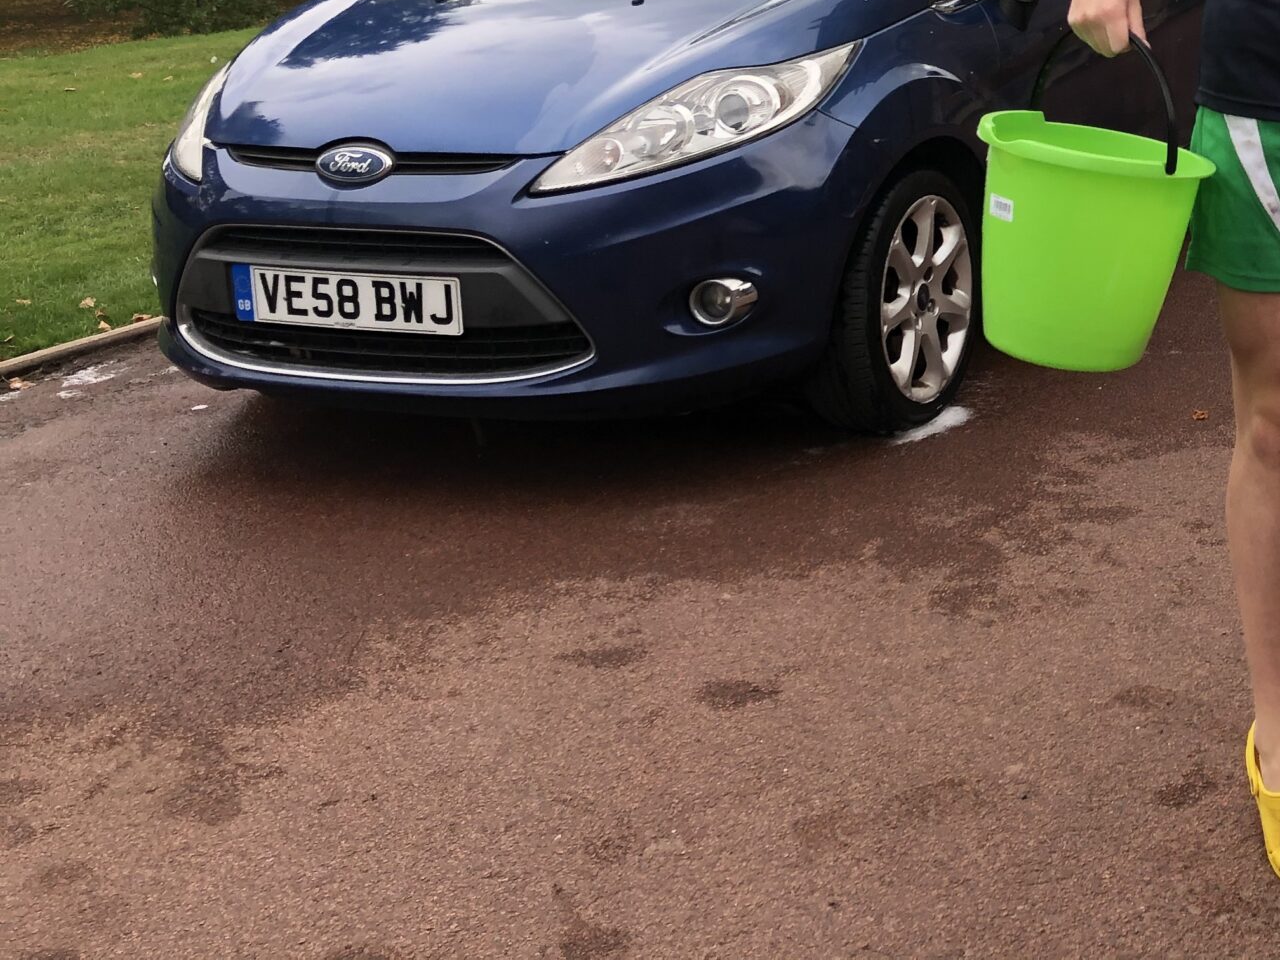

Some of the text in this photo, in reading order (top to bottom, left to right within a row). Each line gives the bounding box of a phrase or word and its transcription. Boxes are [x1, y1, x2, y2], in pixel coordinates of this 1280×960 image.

[329, 152, 372, 173] Ford
[237, 299, 251, 311] GB
[259, 272, 454, 326] VE58 BWJ
